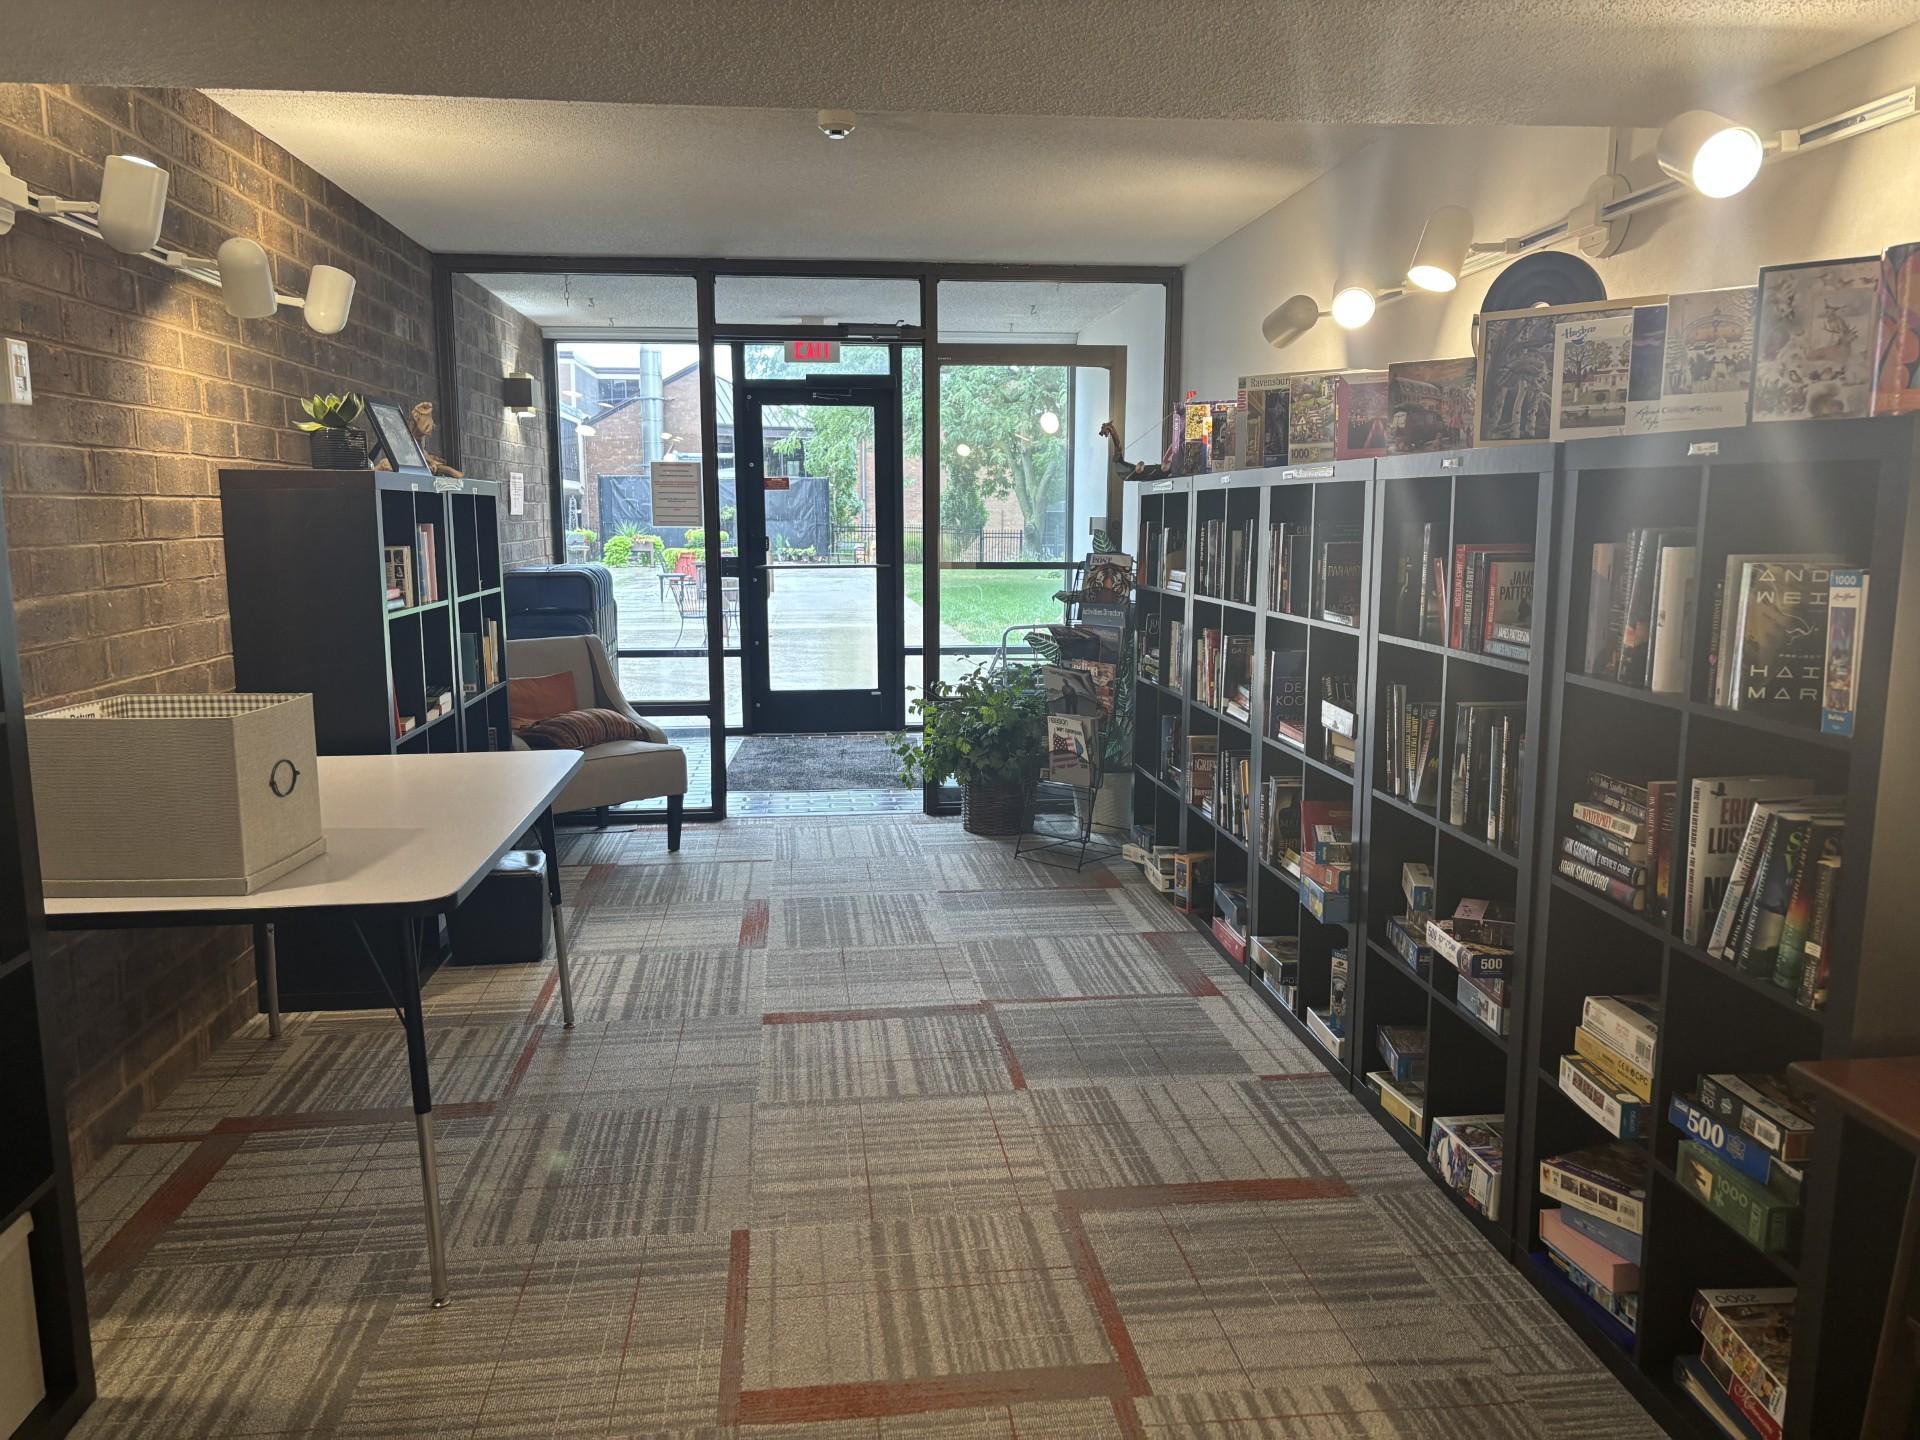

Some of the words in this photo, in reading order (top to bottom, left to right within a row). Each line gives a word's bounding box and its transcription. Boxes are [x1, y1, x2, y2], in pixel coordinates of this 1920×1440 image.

[1561, 325, 1597, 339] Hasbro
[794, 340, 830, 361] EXIT
[1250, 376, 1290, 388] Ravensbur
[1291, 447, 1309, 459] 1000
[1759, 569, 1830, 583] AND
[1835, 575, 1857, 585] 1000
[1500, 585, 1535, 601] PATTER
[1756, 591, 1828, 605] WEI
[1750, 664, 1821, 679] HAI
[1748, 686, 1818, 700] MAR
[1558, 859, 1575, 878] JOHN
[1574, 864, 1610, 892] SANDFORD
[1618, 863, 1632, 878] CODE
[1480, 958, 1503, 970] 500
[1687, 1107, 1724, 1148] 500
[1717, 1175, 1748, 1208] 1000
[1715, 1294, 1759, 1303] 2000
